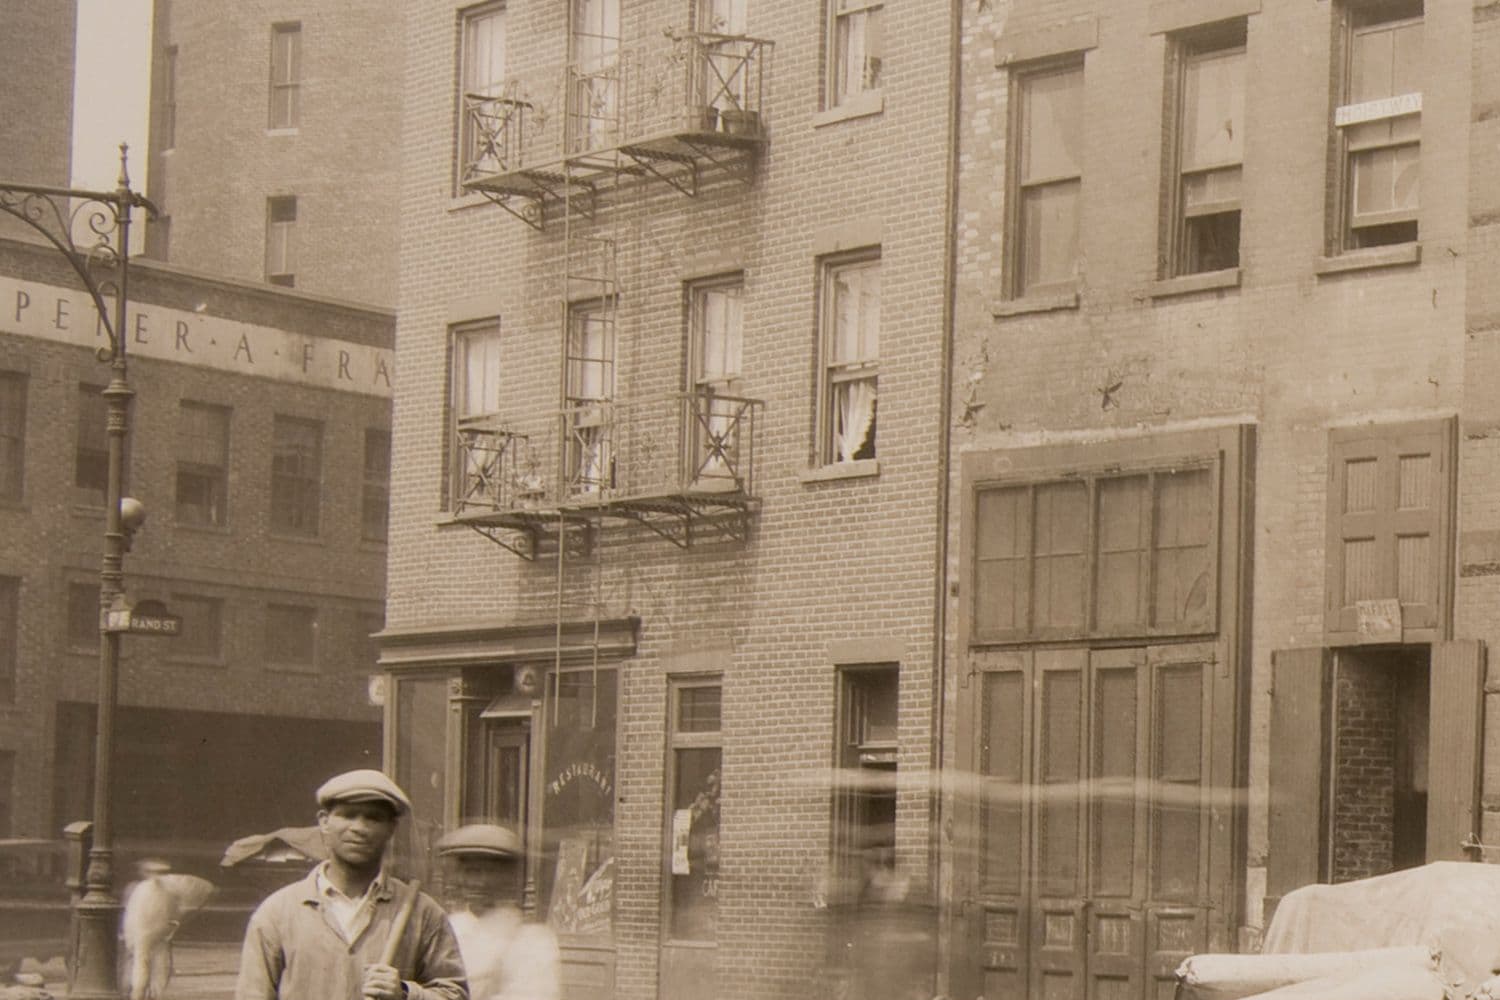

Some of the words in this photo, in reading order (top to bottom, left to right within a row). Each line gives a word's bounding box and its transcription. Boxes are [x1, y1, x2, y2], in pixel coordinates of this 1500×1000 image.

[232, 333, 255, 364] A
[131, 618, 160, 630] RAND
[552, 762, 612, 796] RESTAURANT
